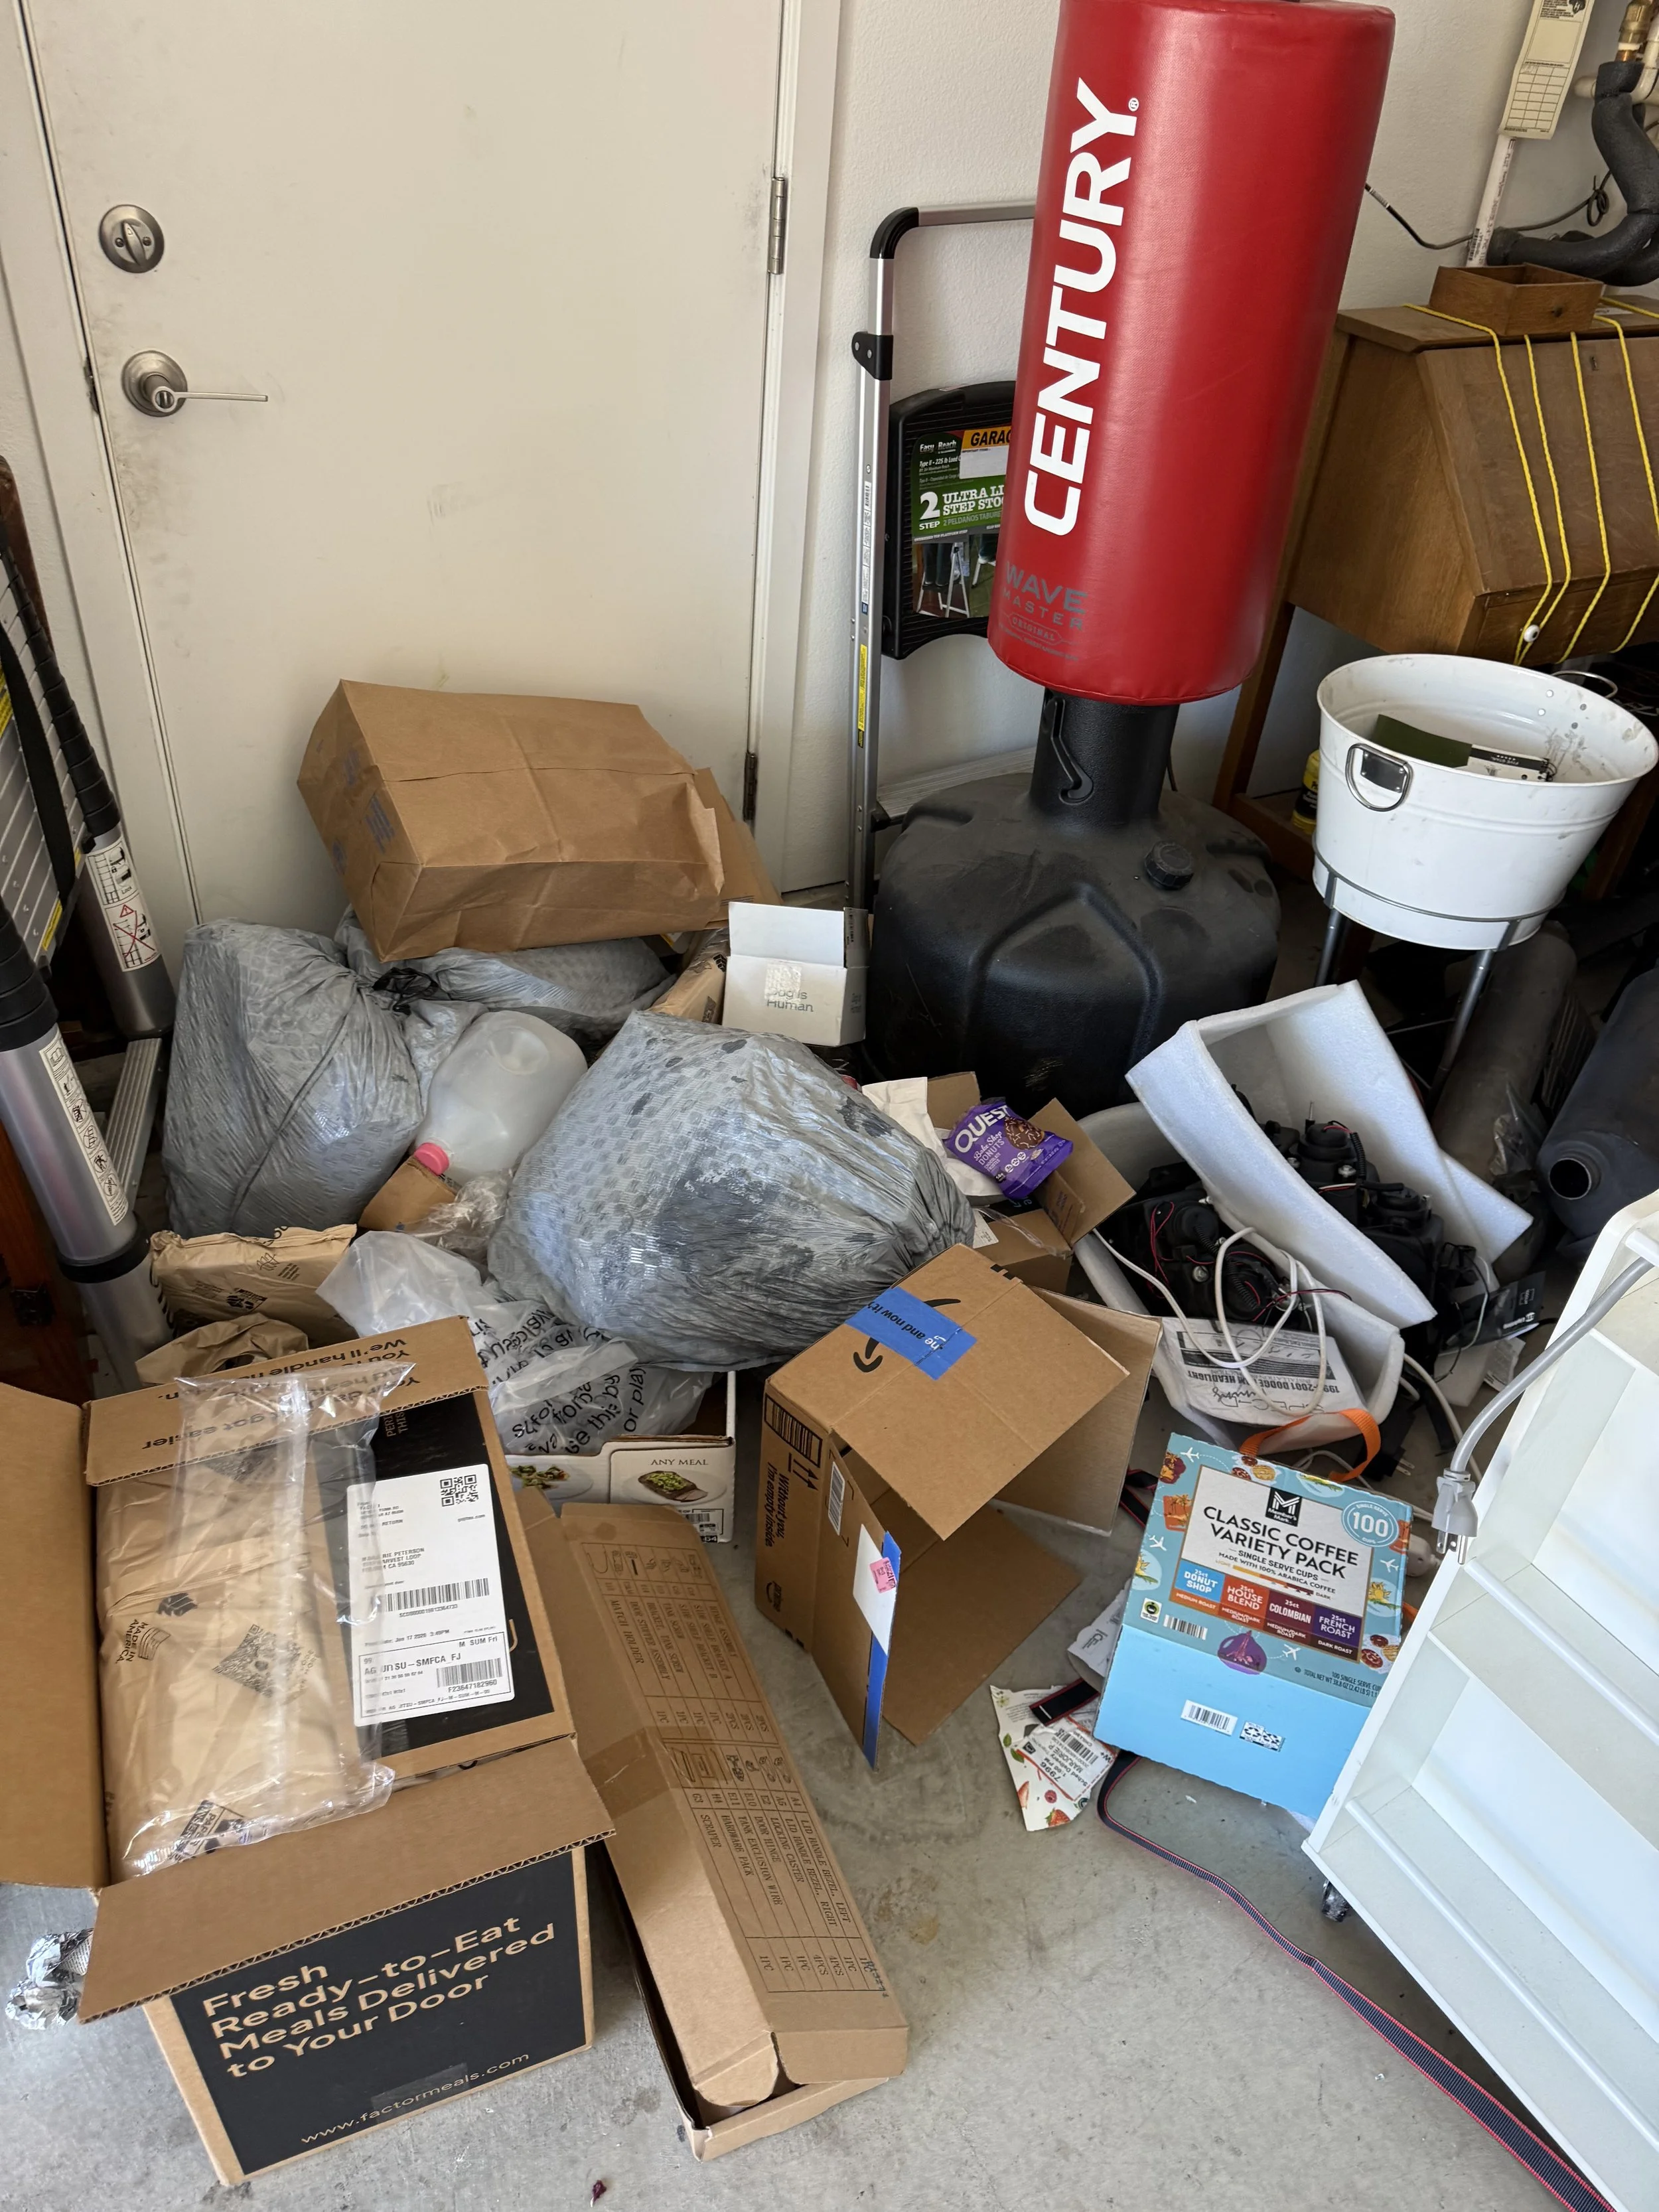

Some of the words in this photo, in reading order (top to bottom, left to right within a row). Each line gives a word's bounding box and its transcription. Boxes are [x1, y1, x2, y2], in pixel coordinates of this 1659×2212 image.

[1025, 77, 1137, 536] CENTURY
[920, 443, 934, 453] Easy
[938, 440, 956, 451] Reach
[920, 491, 940, 520] 2
[942, 487, 987, 504] ULTRA
[943, 501, 975, 516] STEP
[978, 496, 1004, 510] STO
[919, 521, 940, 530] STEP
[1006, 561, 1088, 615] WAVE
[1004, 587, 1083, 630] MASTER
[1012, 617, 1054, 640] ORIGINAL
[797, 989, 808, 999] is
[766, 999, 814, 1012] Human
[954, 1105, 1011, 1153] QUEST
[974, 1143, 988, 1161] Bake
[987, 1131, 1003, 1146] Shop
[979, 1139, 1005, 1165] DONUTS
[879, 1307, 906, 1327] now
[900, 1321, 926, 1341] and
[350, 1337, 406, 1358] We'll
[268, 1352, 345, 1378] handle
[1187, 1368, 1234, 1384] HEADLIGHT
[1258, 1378, 1288, 1390] DODGE
[1291, 1379, 1340, 1395] 199-2001
[392, 1410, 410, 1434] THIS
[767, 1461, 778, 1482] I'm
[764, 1480, 775, 1516] empty
[778, 1473, 789, 1518] Without
[1267, 1507, 1298, 1522] Member's
[1273, 1514, 1290, 1524] Mark
[1349, 1511, 1391, 1538] 100
[776, 1513, 784, 1539] you,
[1201, 1505, 1283, 1542] CLASSIC
[1283, 1532, 1360, 1567] COFFEE
[1207, 1523, 1292, 1562] VARIETY
[1294, 1552, 1348, 1580] PACK
[1194, 1569, 1208, 1578] 25ct
[1218, 1552, 1238, 1562] MADE
[1238, 1558, 1258, 1569] WITH
[1258, 1565, 1277, 1575] 100%
[1277, 1571, 1309, 1585] ARABICA
[1309, 1581, 1336, 1594] COFFEE
[1237, 1550, 1267, 1565] SINGLE
[1267, 1559, 1294, 1574] SERVE
[1295, 1568, 1319, 1582] CUPS
[1183, 1571, 1218, 1588] DONUT
[1185, 1580, 1212, 1594] SHOP
[1239, 1584, 1255, 1593] 25ct
[1175, 1591, 1198, 1602] MEDIUM
[1198, 1599, 1216, 1609] ROAST
[1226, 1585, 1264, 1604] HOUSE
[1226, 1593, 1261, 1611] BLEND
[1284, 1599, 1300, 1609] 25ct
[1315, 1591, 1331, 1600] DARK
[1220, 1606, 1262, 1623] MEDIUM/DARK
[1230, 1614, 1249, 1623] ROAST
[1267, 1602, 1313, 1623] COLOMBIAN
[1331, 1614, 1346, 1623] 25ct
[609, 1600, 629, 1626] MATCH
[621, 1630, 645, 1663] HOLDER
[1265, 1622, 1307, 1639] MEDIUM/DARK
[1276, 1629, 1295, 1639] ROAST
[1318, 1615, 1356, 1633] FRENCH
[1319, 1623, 1352, 1639] ROAST
[133, 1623, 149, 1649] MADE
[628, 1601, 642, 1616] DOOR
[648, 1647, 670, 1680] ASSEMBLY
[126, 1651, 135, 1661] IN
[1317, 1639, 1333, 1649] DARK
[1333, 1645, 1353, 1655] ROAST
[1303, 1668, 1317, 1678] TOTAL
[1316, 1672, 1325, 1681] NET
[1325, 1676, 1333, 1684] WT
[1342, 1681, 1348, 1690] OZ
[1339, 1674, 1356, 1684] SINGLE
[1356, 1680, 1372, 1690] SERVE
[656, 1710, 670, 1724] 1PC
[675, 1710, 689, 1724] 1PC
[1046, 1740, 1056, 1750] P.
[1043, 1756, 1054, 1767] PM
[1048, 1751, 1072, 1773] Delivery
[1052, 1745, 1084, 1775] MARJORIE
[1098, 1749, 1112, 1763] W+
[1039, 1760, 1062, 1782] 7996
[1053, 1764, 1066, 1777] 1:00
[1070, 1770, 1088, 1788] Sched
[784, 1818, 798, 1833] LID
[800, 1819, 813, 1833] LID
[790, 1834, 812, 1864] HANDLE
[806, 1837, 827, 1866] HANDLE
[691, 1793, 703, 1803] G3
[697, 1814, 723, 1848] SCRAPER
[758, 1954, 774, 1972] 1PC
[710, 1793, 723, 1803] H4
[719, 1815, 746, 1853] HARDWARE
[737, 1857, 755, 1876] PACK
[778, 1955, 794, 1972] 1PC
[803, 1868, 825, 1895] BEZEL,
[820, 1870, 839, 1895] BEZEL,
[737, 1816, 753, 1835] TANK
[745, 1839, 774, 1881] EXCLUSION
[766, 1885, 783, 1906] WIRE
[796, 1955, 810, 1971] 1PC
[753, 1816, 768, 1835] DOOR
[762, 1839, 780, 1862] HINGE
[812, 1954, 830, 1976] 4PCS
[768, 1817, 792, 1850] LOCKING
[783, 1853, 806, 1882] CASTER
[827, 1955, 845, 1976] 4PCS
[817, 1901, 838, 1927] RIGHT
[833, 1901, 852, 1923] LEFT
[843, 1956, 858, 1972] 1PC
[211, 1916, 522, 2039] Ready-to-Eat
[203, 1963, 329, 2018] Fresh
[220, 2006, 348, 2059] Meals
[359, 1921, 555, 2011] Delivered
[227, 2055, 275, 2078] to
[283, 2016, 378, 2057] Your
[388, 1974, 489, 2023] Door
[301, 2053, 530, 2144] www.factormeals.com
